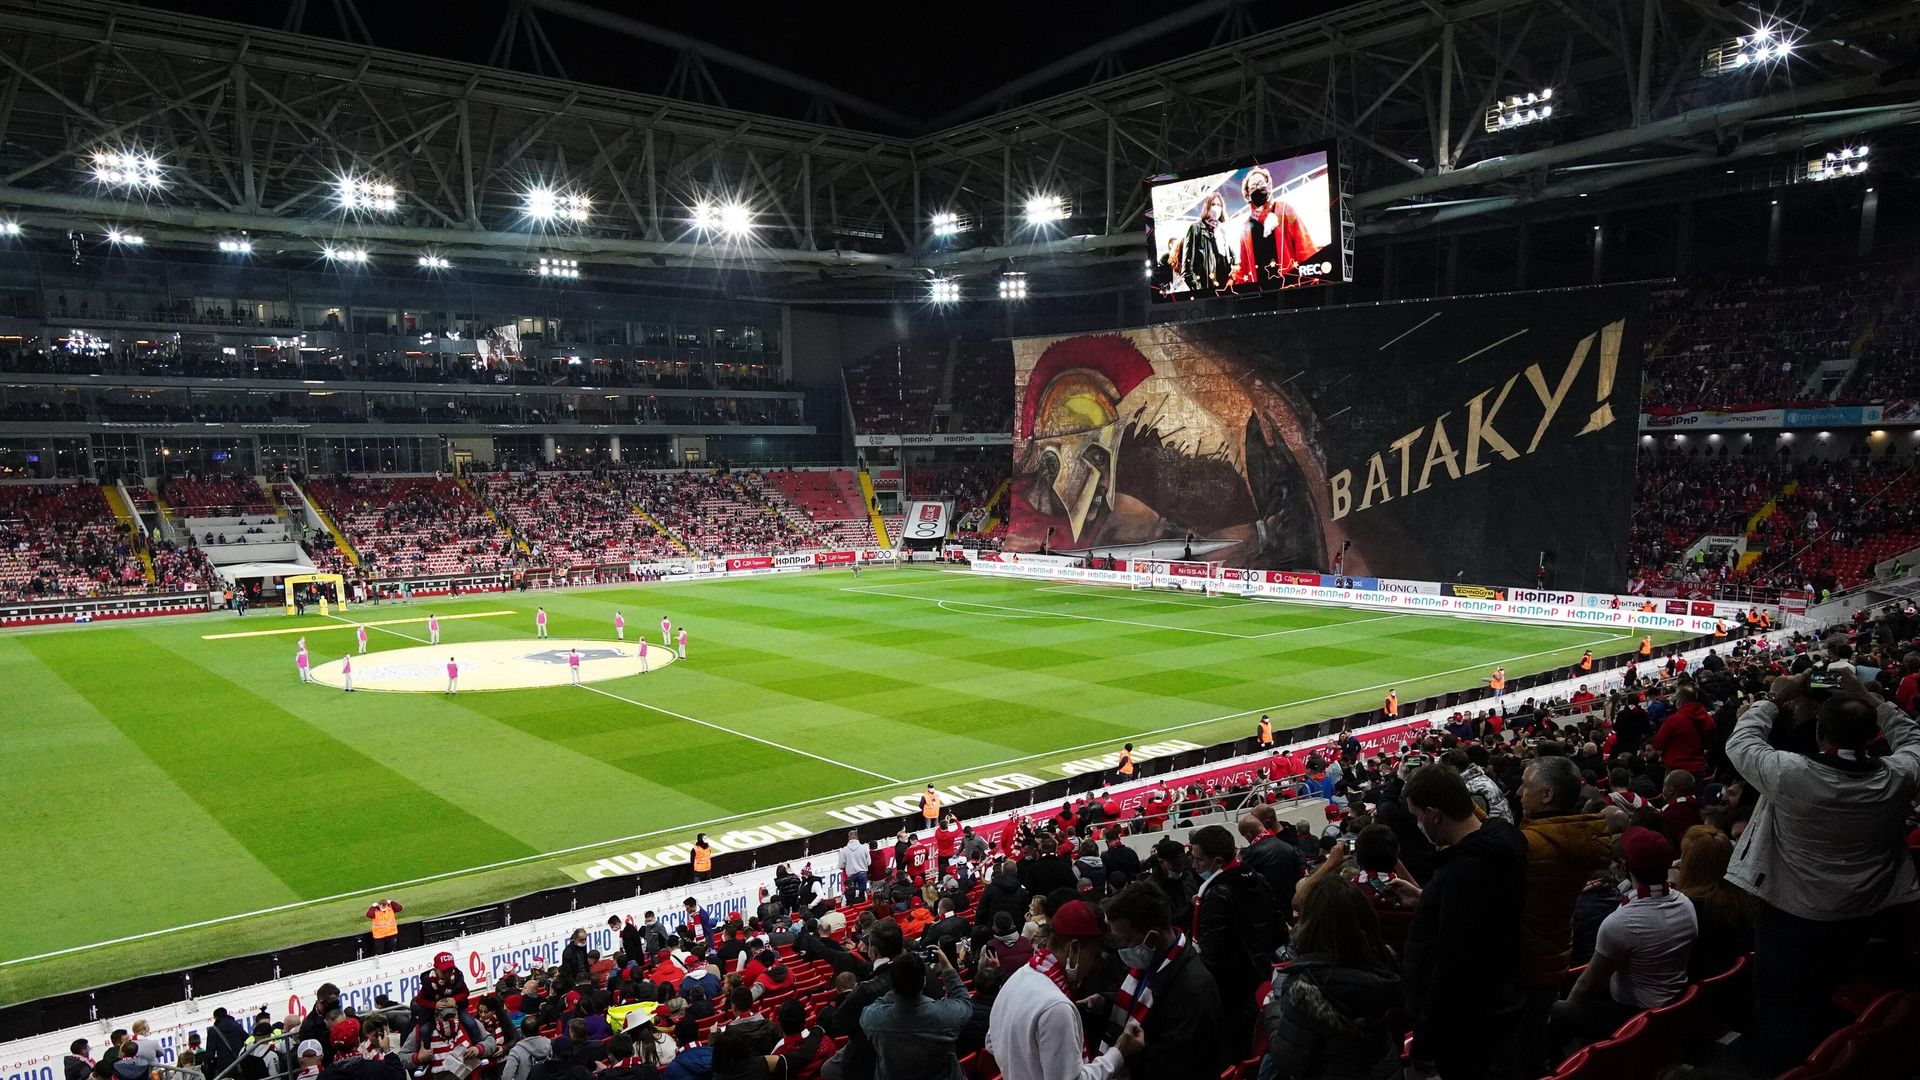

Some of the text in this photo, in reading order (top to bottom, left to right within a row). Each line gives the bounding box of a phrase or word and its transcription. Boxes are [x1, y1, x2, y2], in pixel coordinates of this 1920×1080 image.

[1299, 263, 1321, 276] REC
[775, 555, 811, 566] НФПРиР
[1178, 567, 1207, 576] NISSAN
[1269, 585, 1308, 595] НФПРиР
[1311, 589, 1351, 599] НФПРиР
[1355, 592, 1398, 604] НФПРиР
[1404, 596, 1449, 608] НФПРиР
[1454, 600, 1502, 612] НФПРиР
[1508, 603, 1559, 617] НФПРиР
[1567, 609, 1622, 622] НФПРиР
[1514, 590, 1575, 605] НФПРиР
[914, 853, 925, 867] 80
